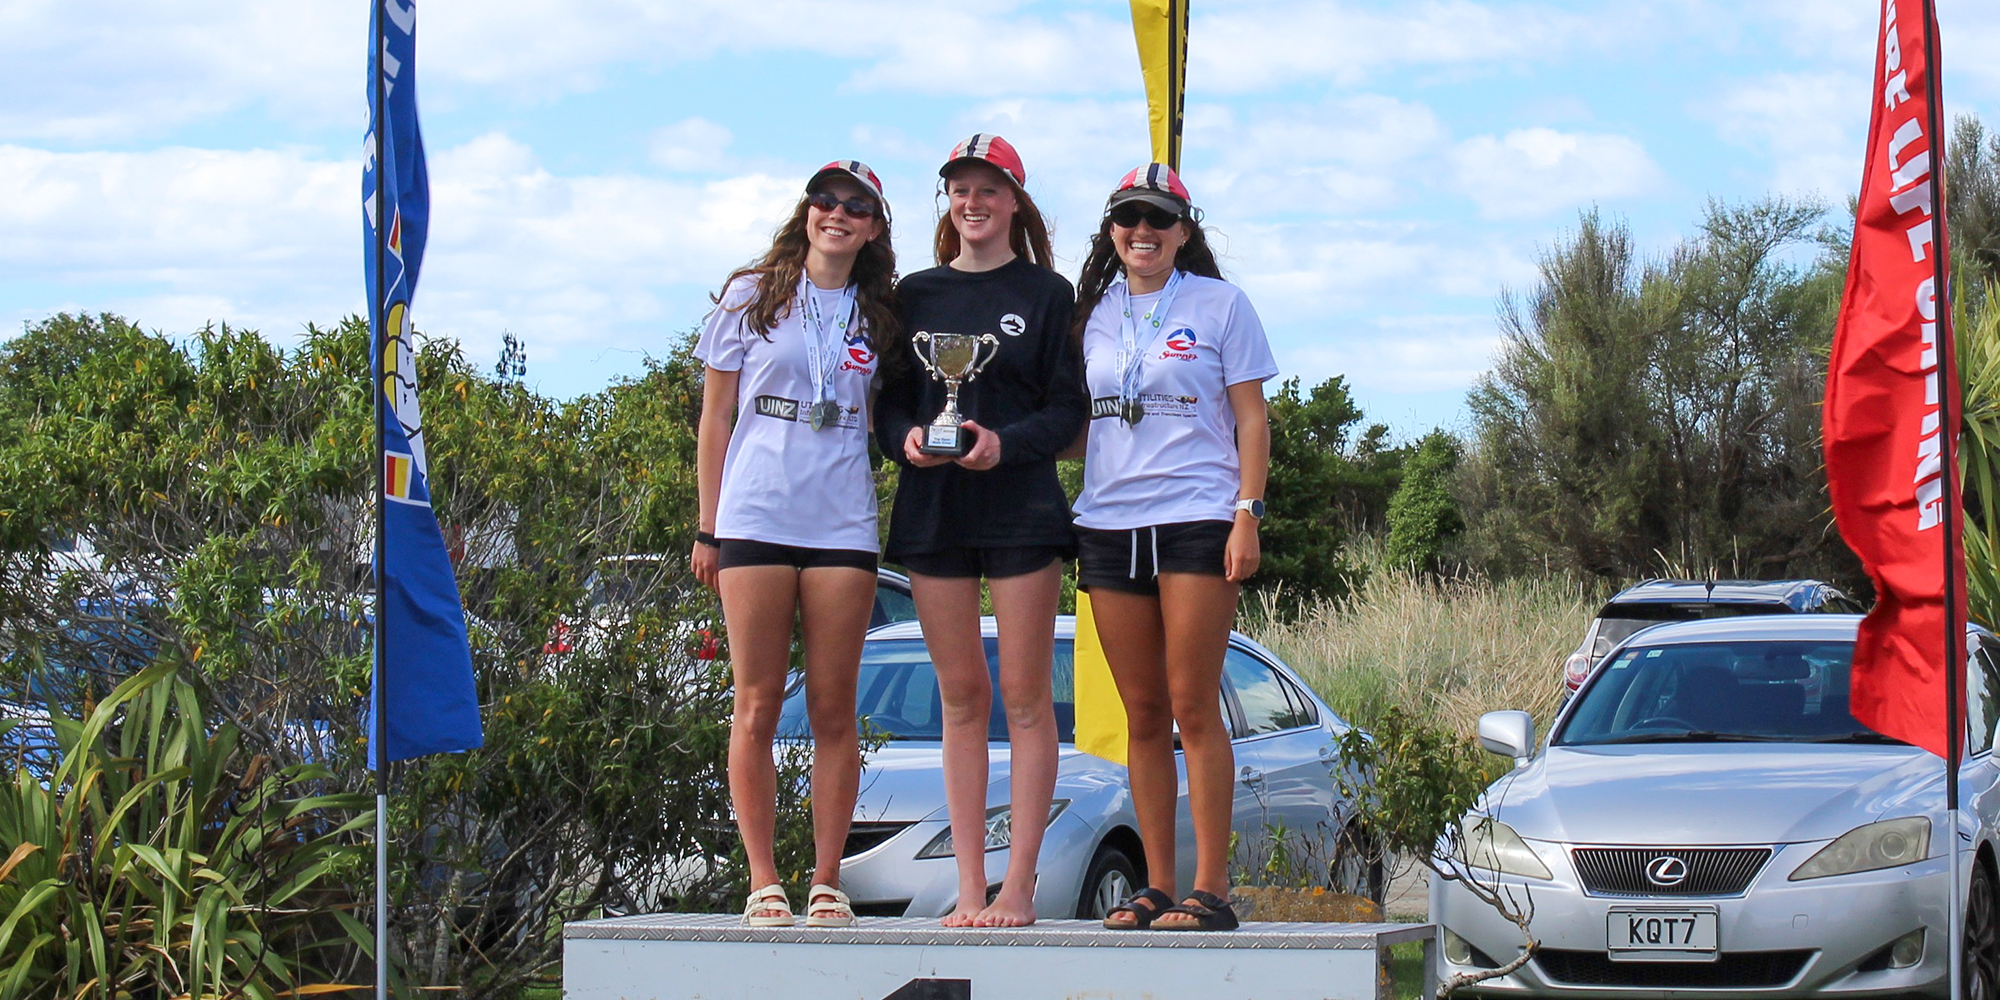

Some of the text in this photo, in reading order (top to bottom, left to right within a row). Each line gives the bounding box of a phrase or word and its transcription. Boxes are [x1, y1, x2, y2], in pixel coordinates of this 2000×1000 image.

[760, 398, 796, 418] UINZ
[1091, 399, 1120, 416] UIN
[1629, 918, 1696, 944] KQT7
